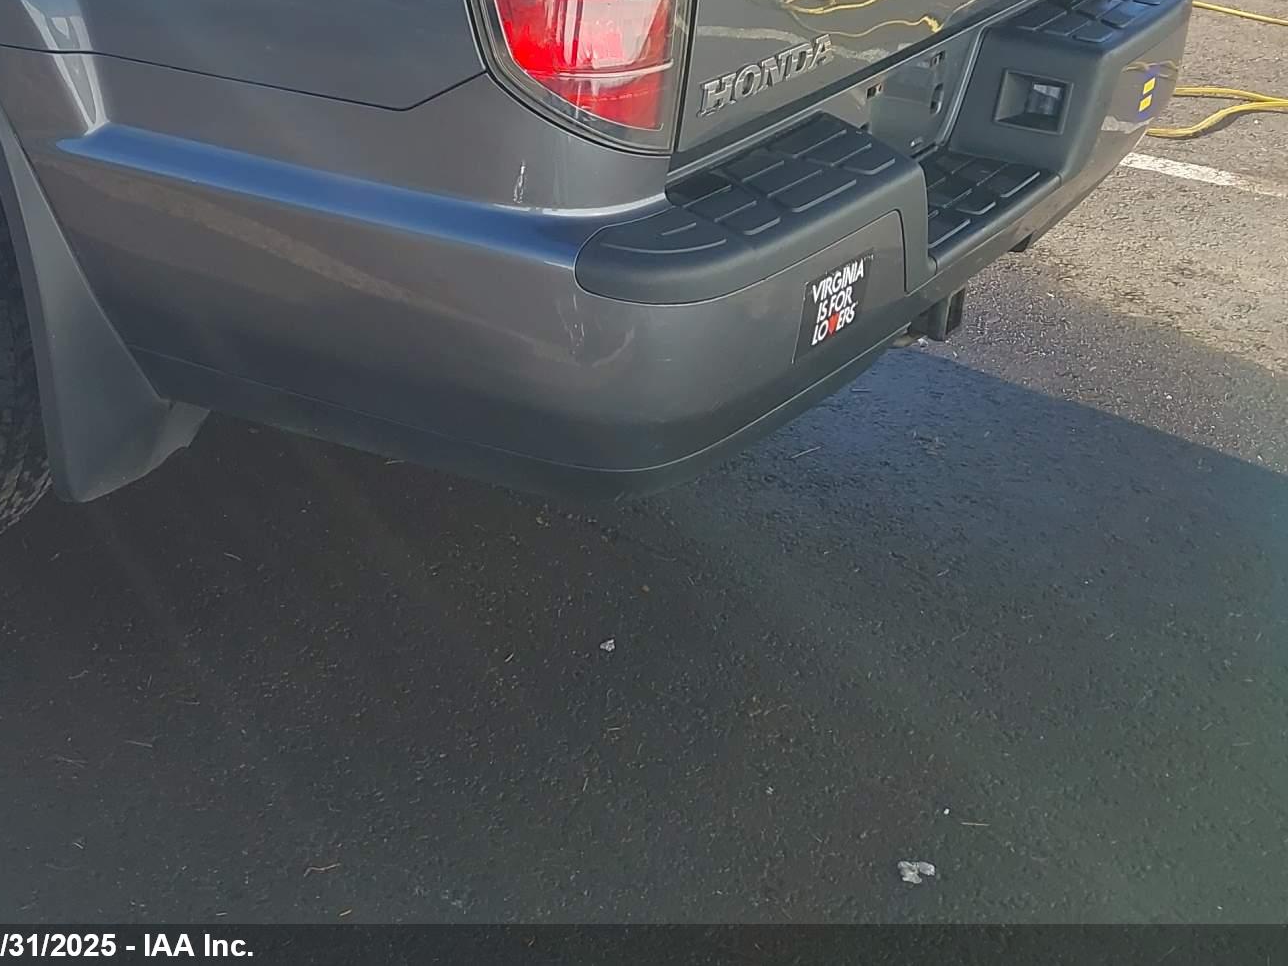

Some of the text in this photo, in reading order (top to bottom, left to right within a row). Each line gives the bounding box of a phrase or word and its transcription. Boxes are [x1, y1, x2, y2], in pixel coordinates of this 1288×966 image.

[697, 34, 833, 117] HONDA
[812, 258, 864, 304] VIRGINIA
[816, 286, 853, 324] IS FOR
